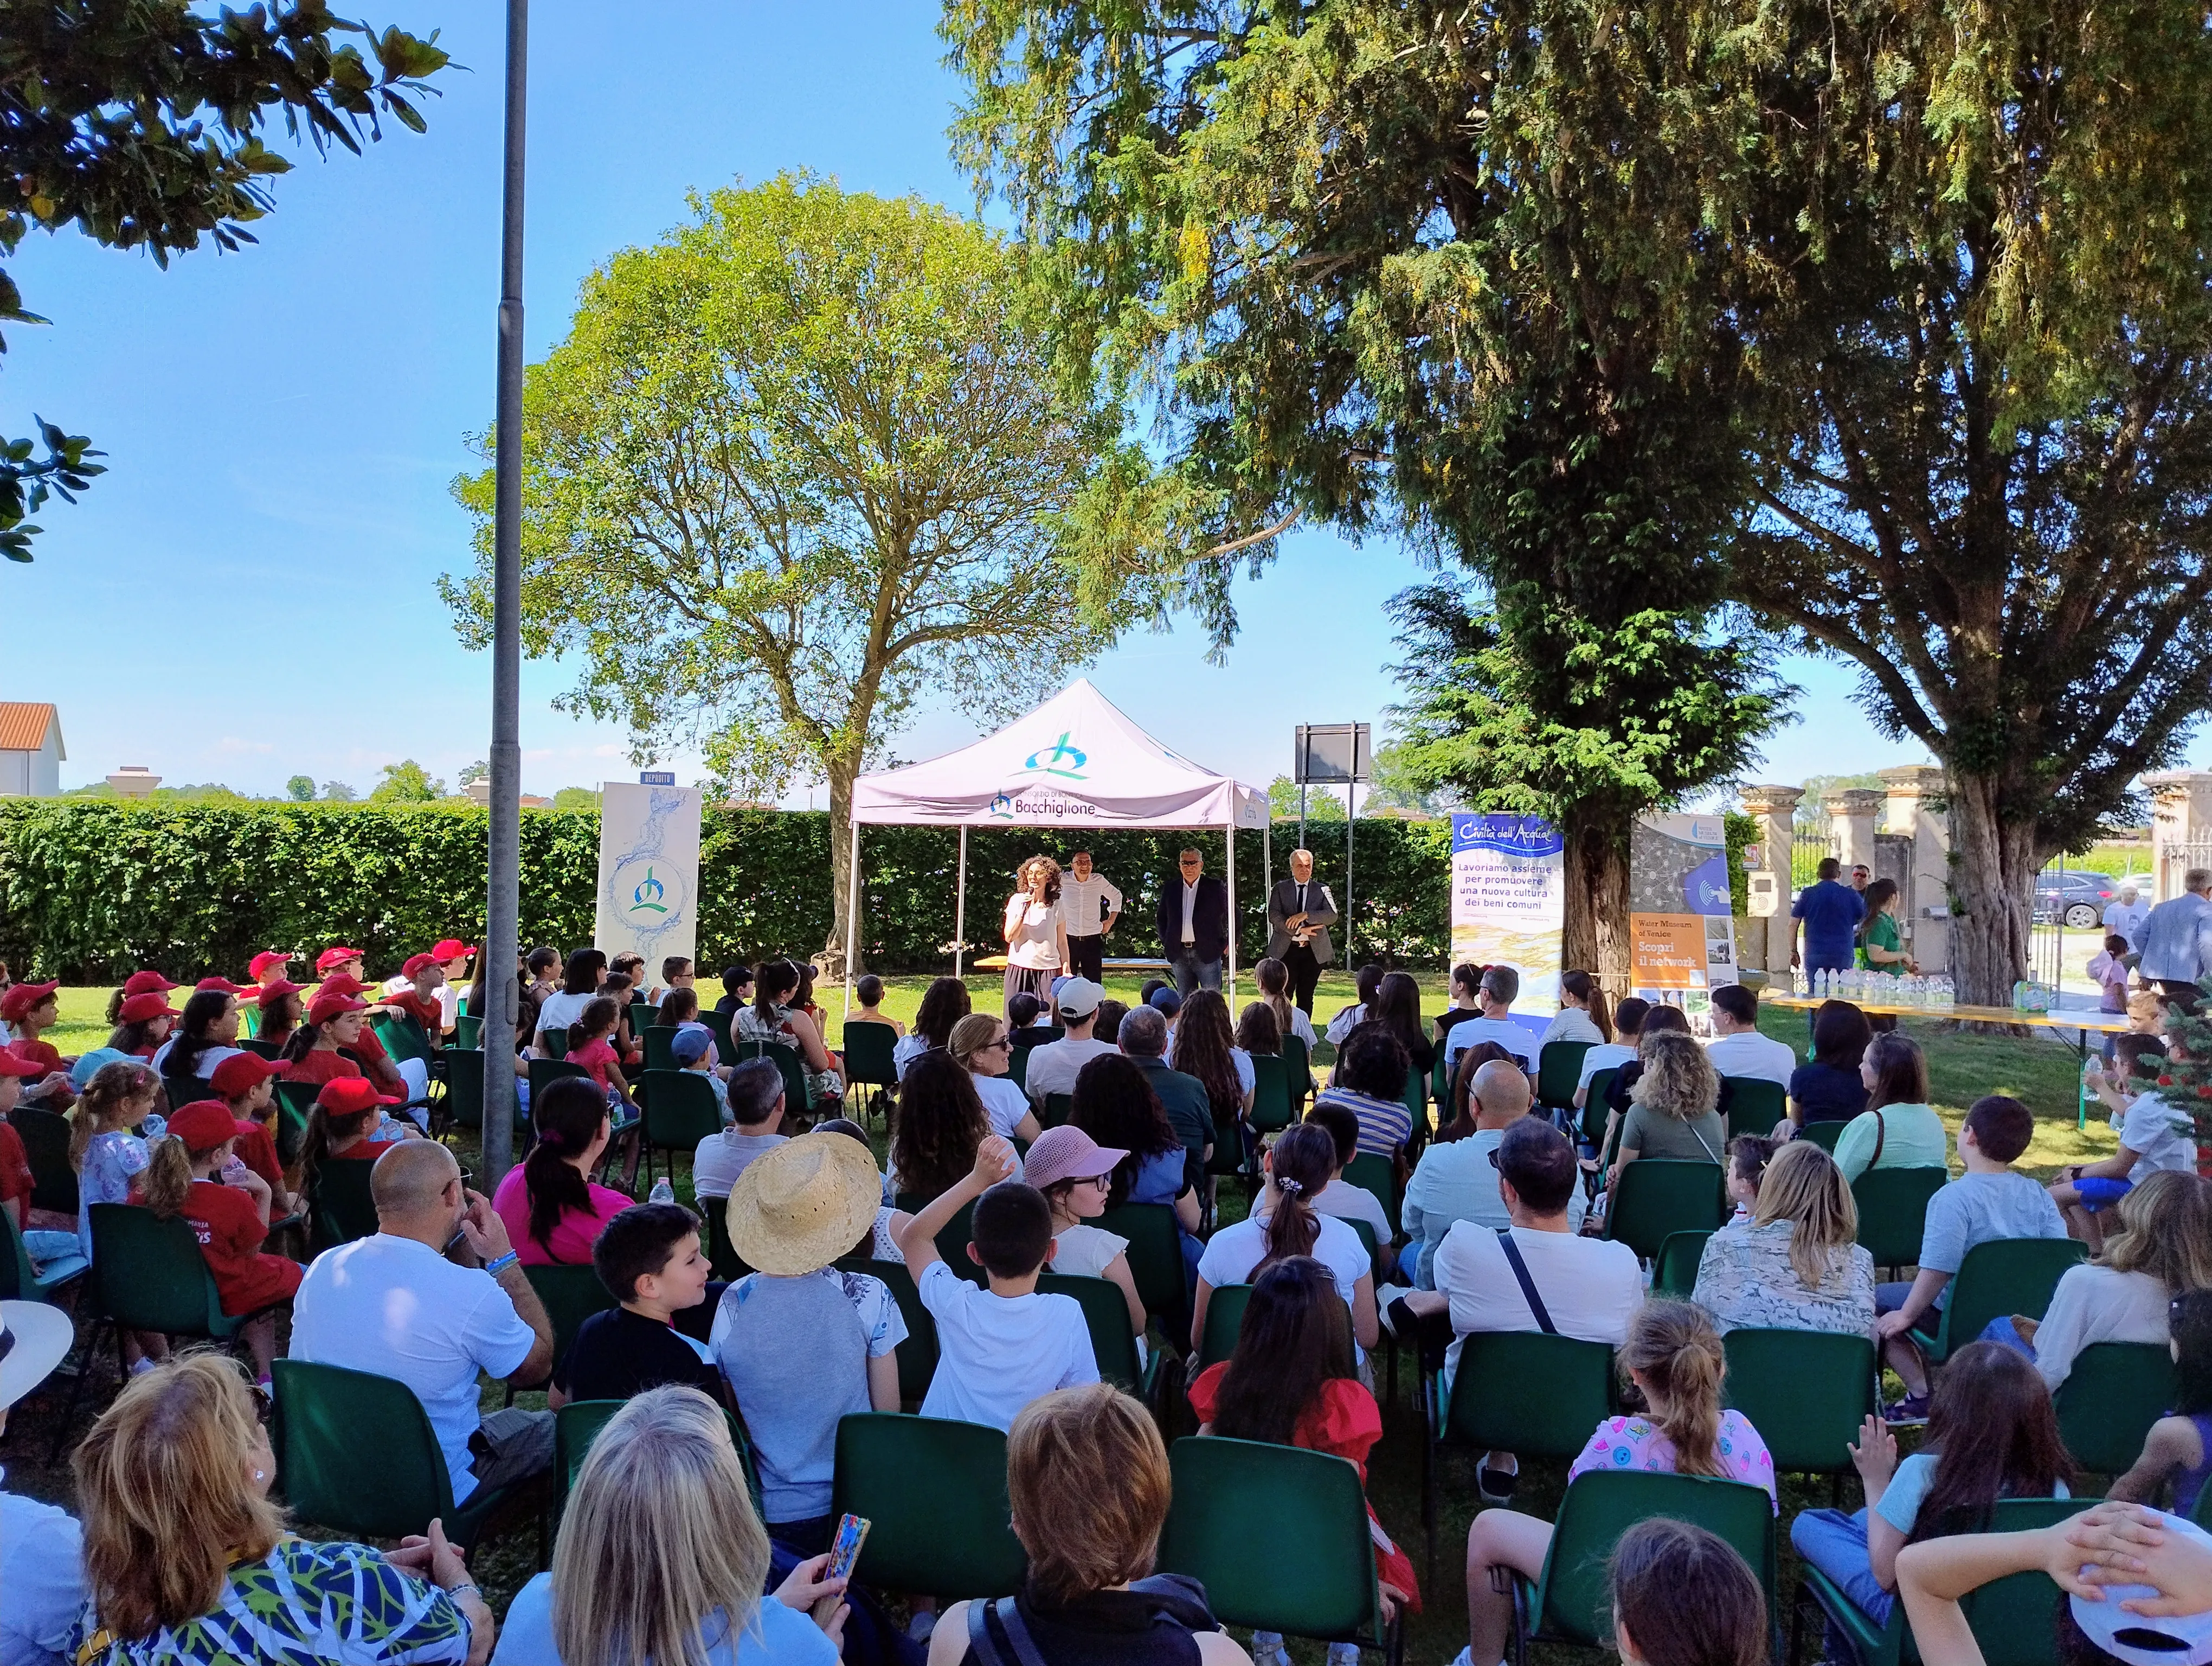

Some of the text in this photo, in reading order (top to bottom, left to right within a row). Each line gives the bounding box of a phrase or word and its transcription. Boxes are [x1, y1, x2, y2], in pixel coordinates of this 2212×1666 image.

[645, 774, 670, 783] DEPOSITO
[1015, 798, 1095, 817] Bacchiglione
[1459, 821, 1496, 840] Civiltà
[1459, 863, 1552, 874] Lavoriamo assieme
[1485, 877, 1542, 885] promuovere
[1514, 889, 1547, 898] cultura
[1465, 898, 1541, 909] dei beni comuni
[1638, 941, 1674, 955] Scopri
[1638, 955, 1696, 967] il network
